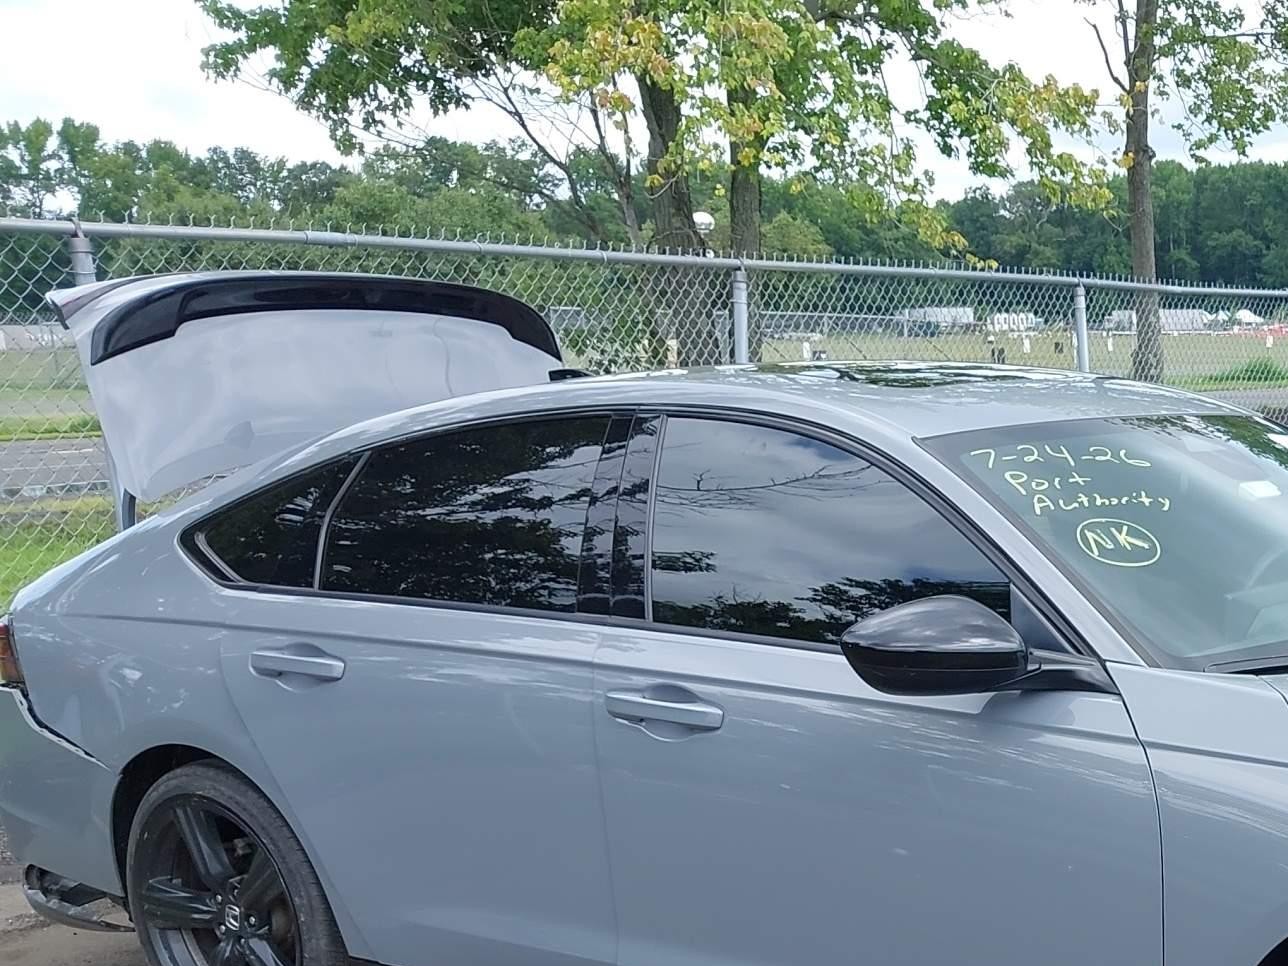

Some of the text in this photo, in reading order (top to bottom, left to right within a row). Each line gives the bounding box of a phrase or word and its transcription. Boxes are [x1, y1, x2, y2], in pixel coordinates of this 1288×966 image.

[970, 444, 1152, 469] 7-24-26
[1004, 471, 1092, 496] Port
[1033, 491, 1171, 516] Authority
